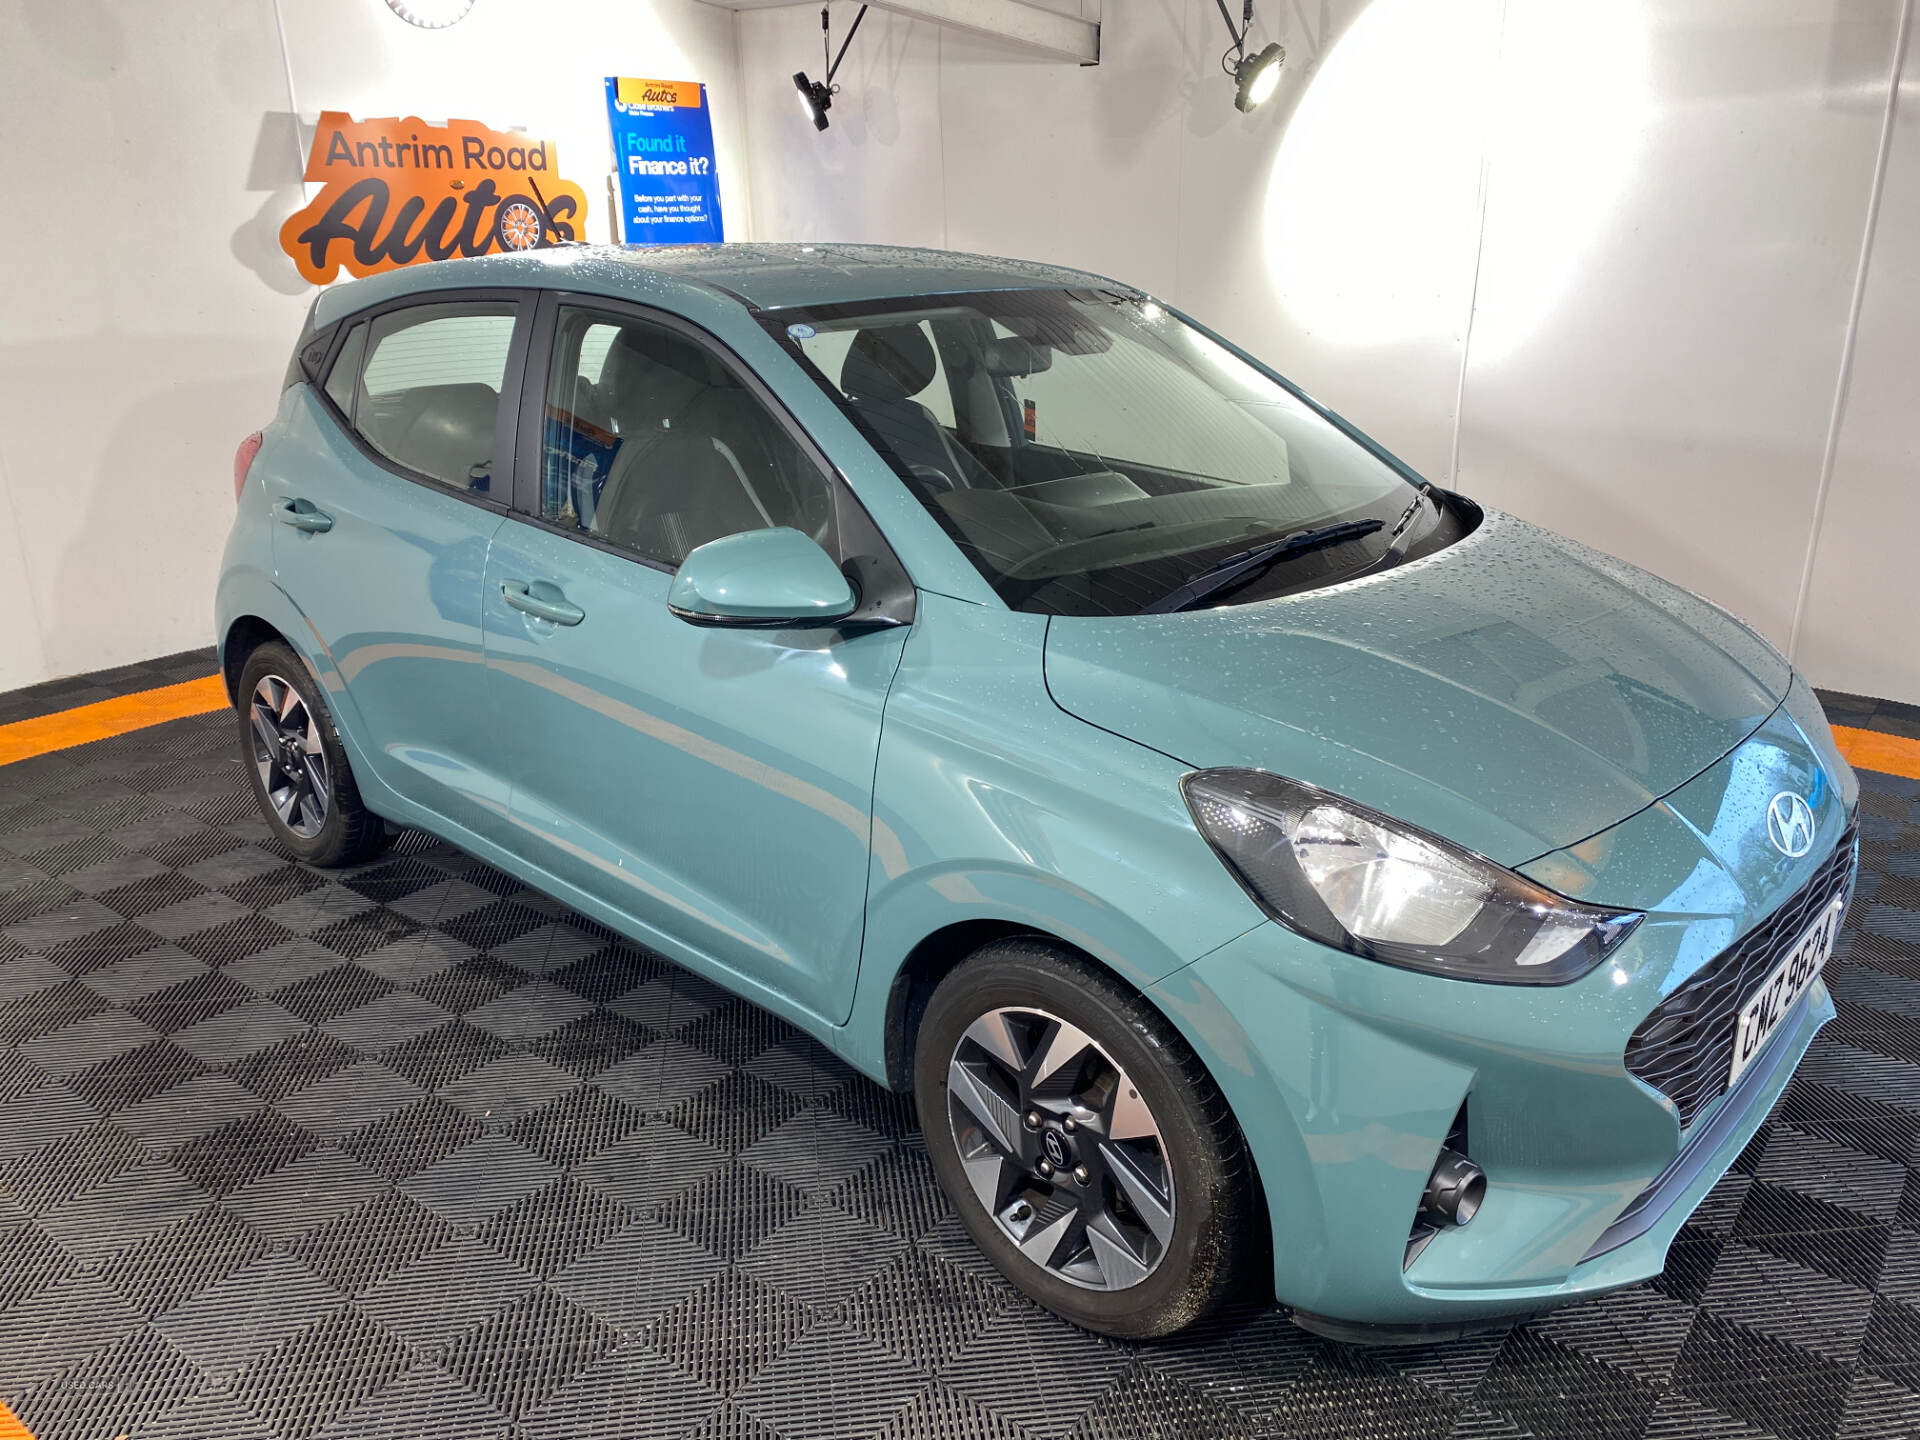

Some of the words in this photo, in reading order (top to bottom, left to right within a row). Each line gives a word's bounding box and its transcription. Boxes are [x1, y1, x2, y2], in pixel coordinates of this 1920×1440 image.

[642, 88, 677, 103] Autos
[326, 130, 453, 169] Antrim
[462, 135, 548, 172] Road
[627, 132, 672, 152] Found
[676, 134, 686, 152] it
[628, 156, 687, 175] Finance
[689, 156, 709, 175] it?
[634, 194, 652, 202] Before
[653, 195, 664, 203] you
[665, 195, 676, 203] part
[677, 194, 689, 202] with
[689, 195, 702, 203] your
[638, 205, 653, 213] cash,
[680, 205, 701, 213] thought
[298, 178, 577, 269] Autos
[650, 216, 663, 224] your
[664, 215, 684, 223] finance
[685, 214, 708, 223] options?
[1743, 969, 1785, 1062] CMZ
[1785, 913, 1831, 1007] 9624
